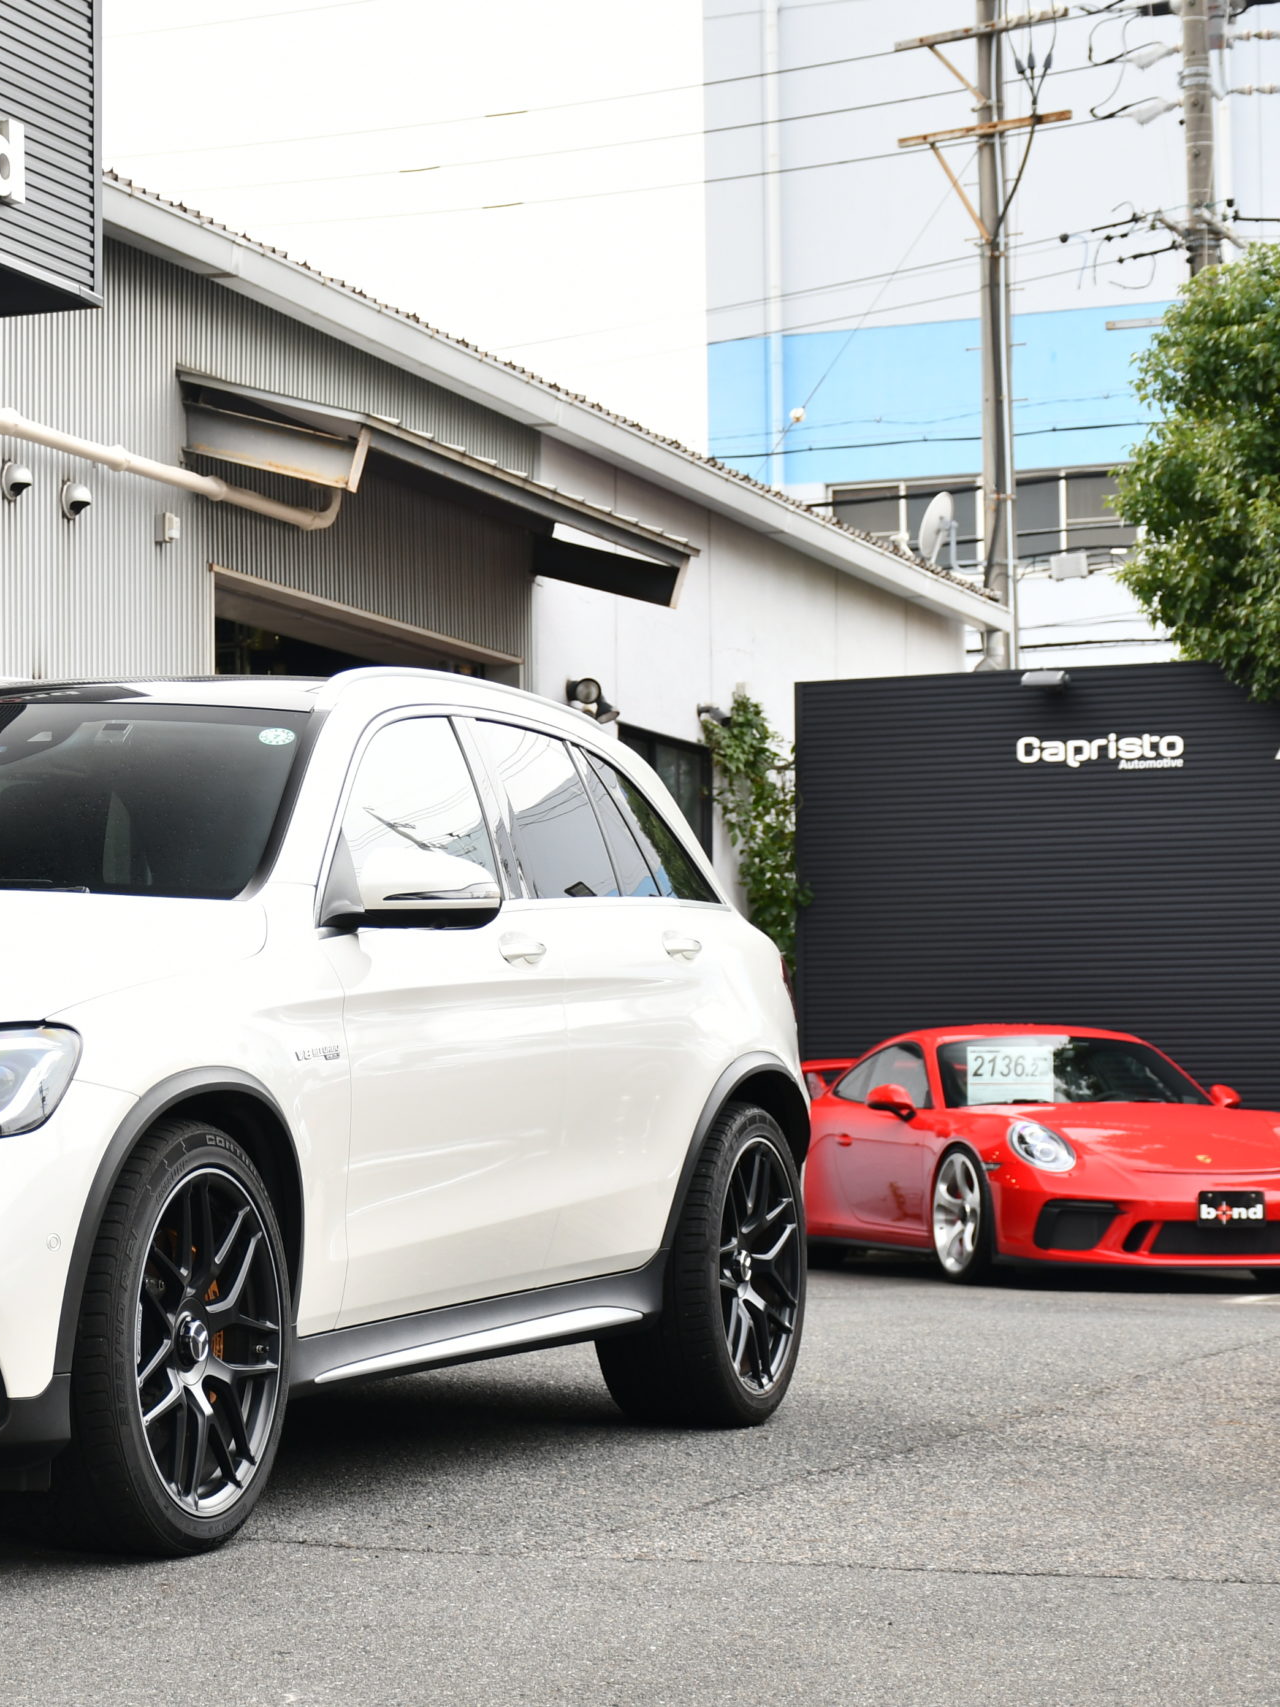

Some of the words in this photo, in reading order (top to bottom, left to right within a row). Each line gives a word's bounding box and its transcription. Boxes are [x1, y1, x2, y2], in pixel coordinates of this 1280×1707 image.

[1016, 733, 1184, 768] Capristo
[1118, 758, 1183, 770] Automotive
[972, 1055, 1039, 1077] 2136.2
[1200, 1203, 1263, 1221] bond
